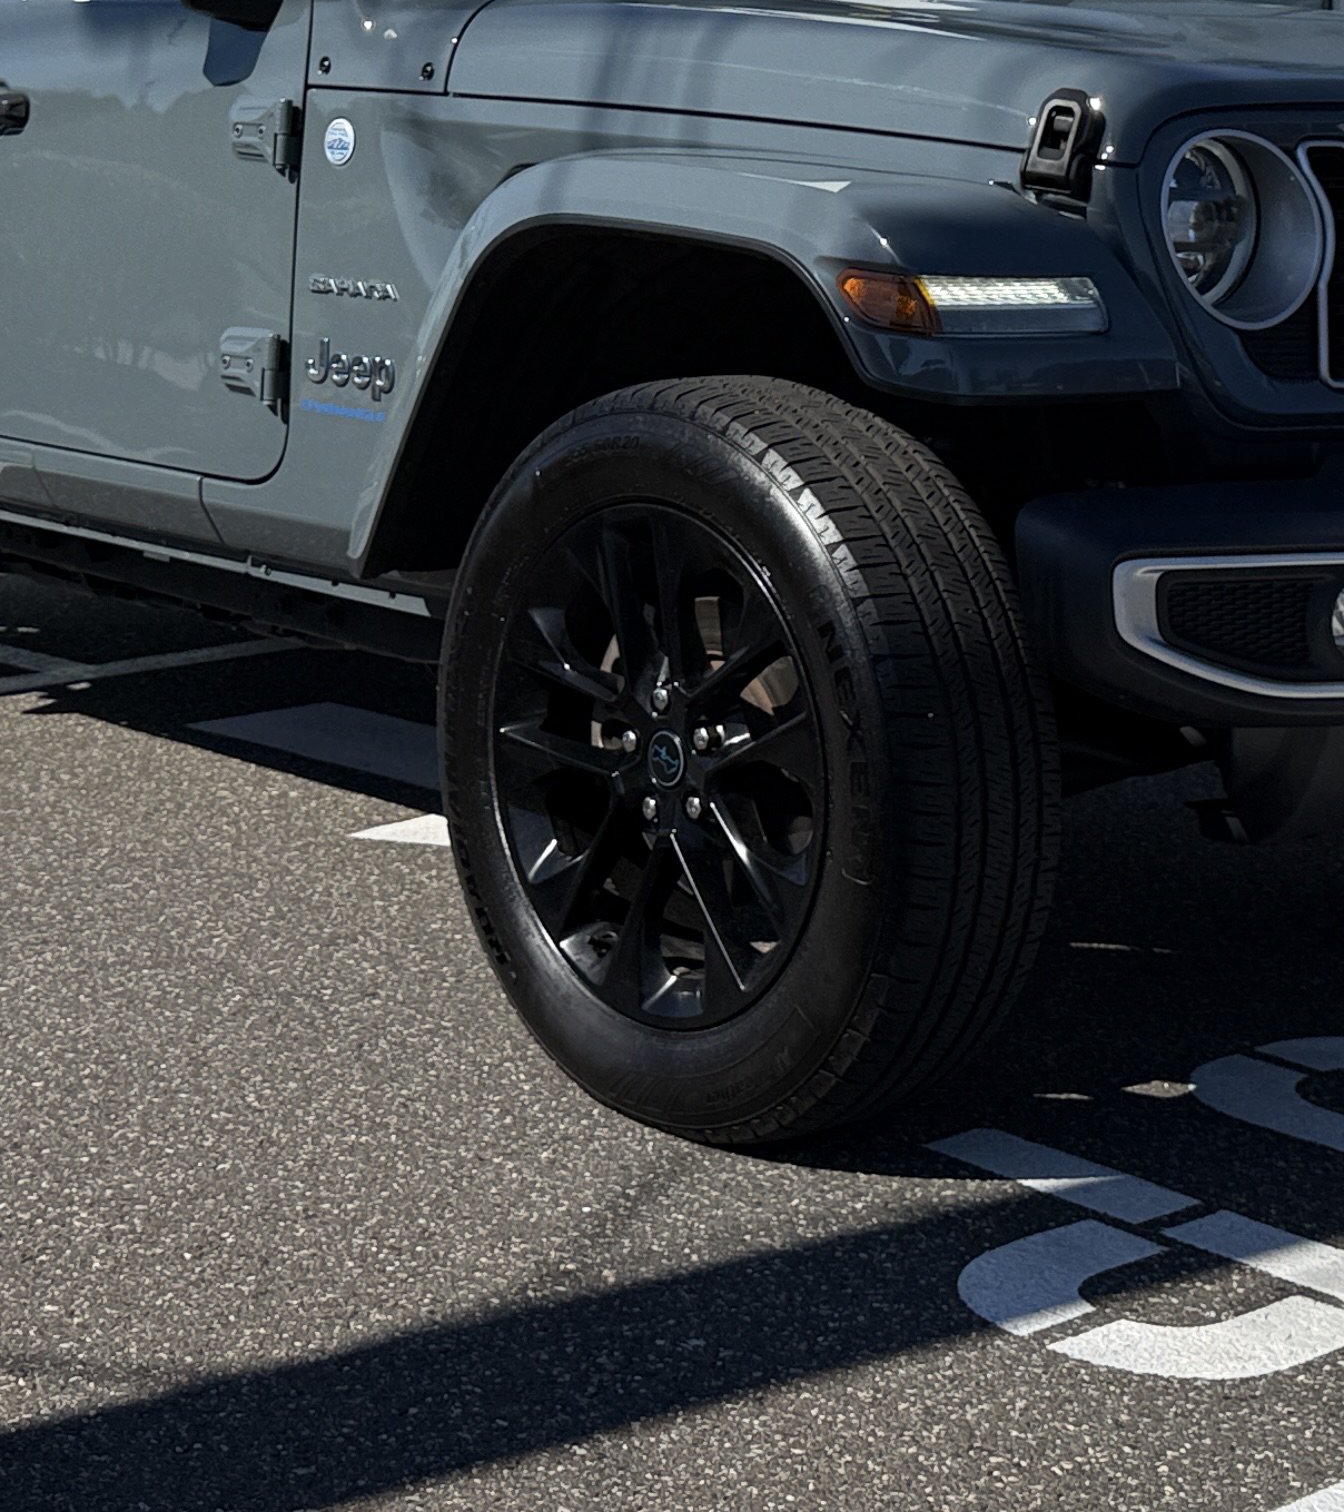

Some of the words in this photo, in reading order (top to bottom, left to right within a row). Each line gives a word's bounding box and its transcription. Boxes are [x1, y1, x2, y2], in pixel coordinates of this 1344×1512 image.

[308, 273, 400, 301] SAHARA
[305, 337, 396, 402] Jeep
[815, 614, 870, 856] NEXEN
